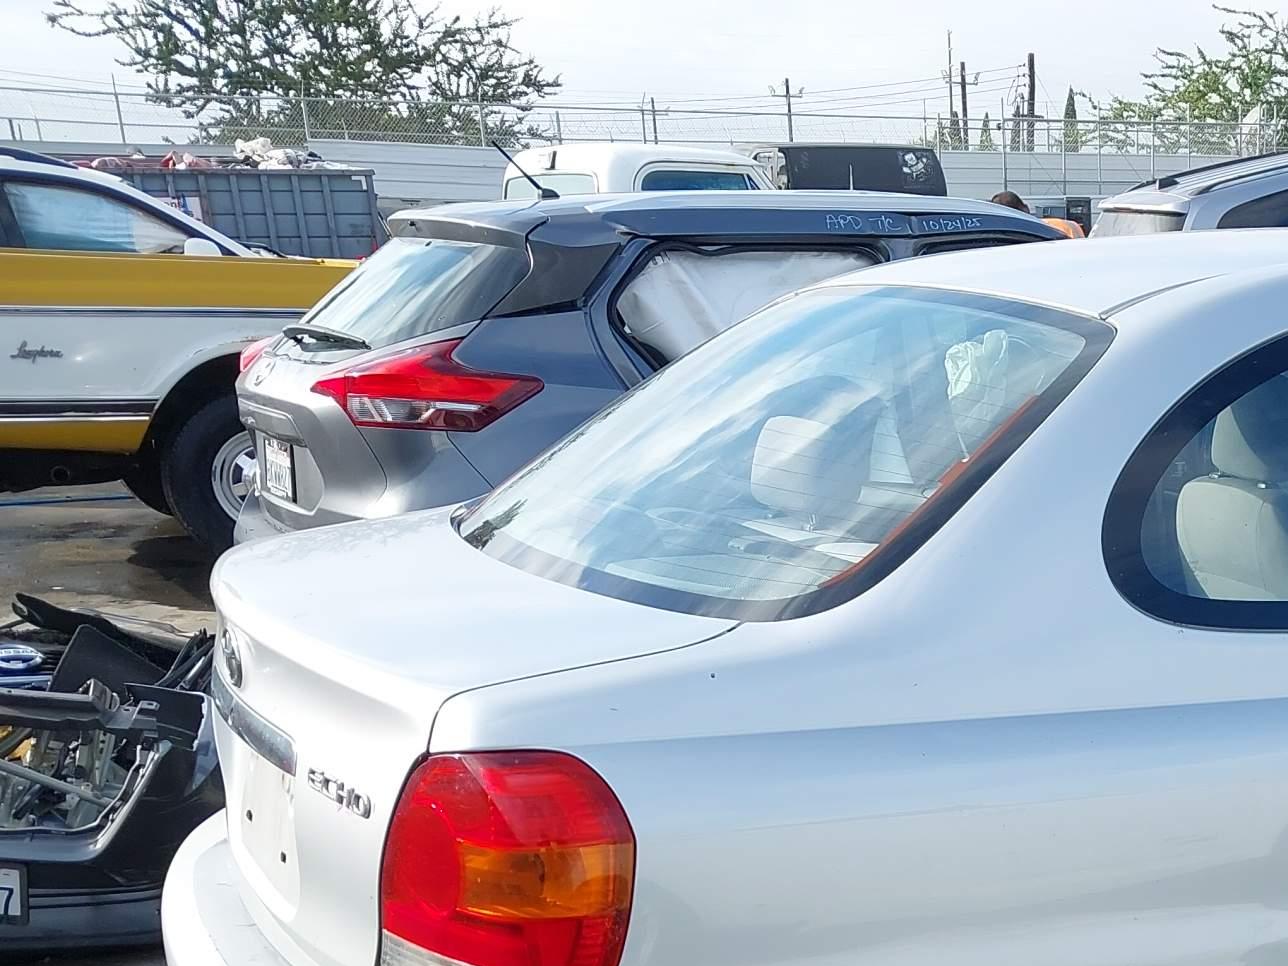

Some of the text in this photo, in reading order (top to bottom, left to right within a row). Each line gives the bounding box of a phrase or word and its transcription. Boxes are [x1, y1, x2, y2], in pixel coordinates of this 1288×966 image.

[825, 214, 863, 230] APD
[922, 216, 983, 232] 10/24/25
[307, 767, 372, 819] ECHO
